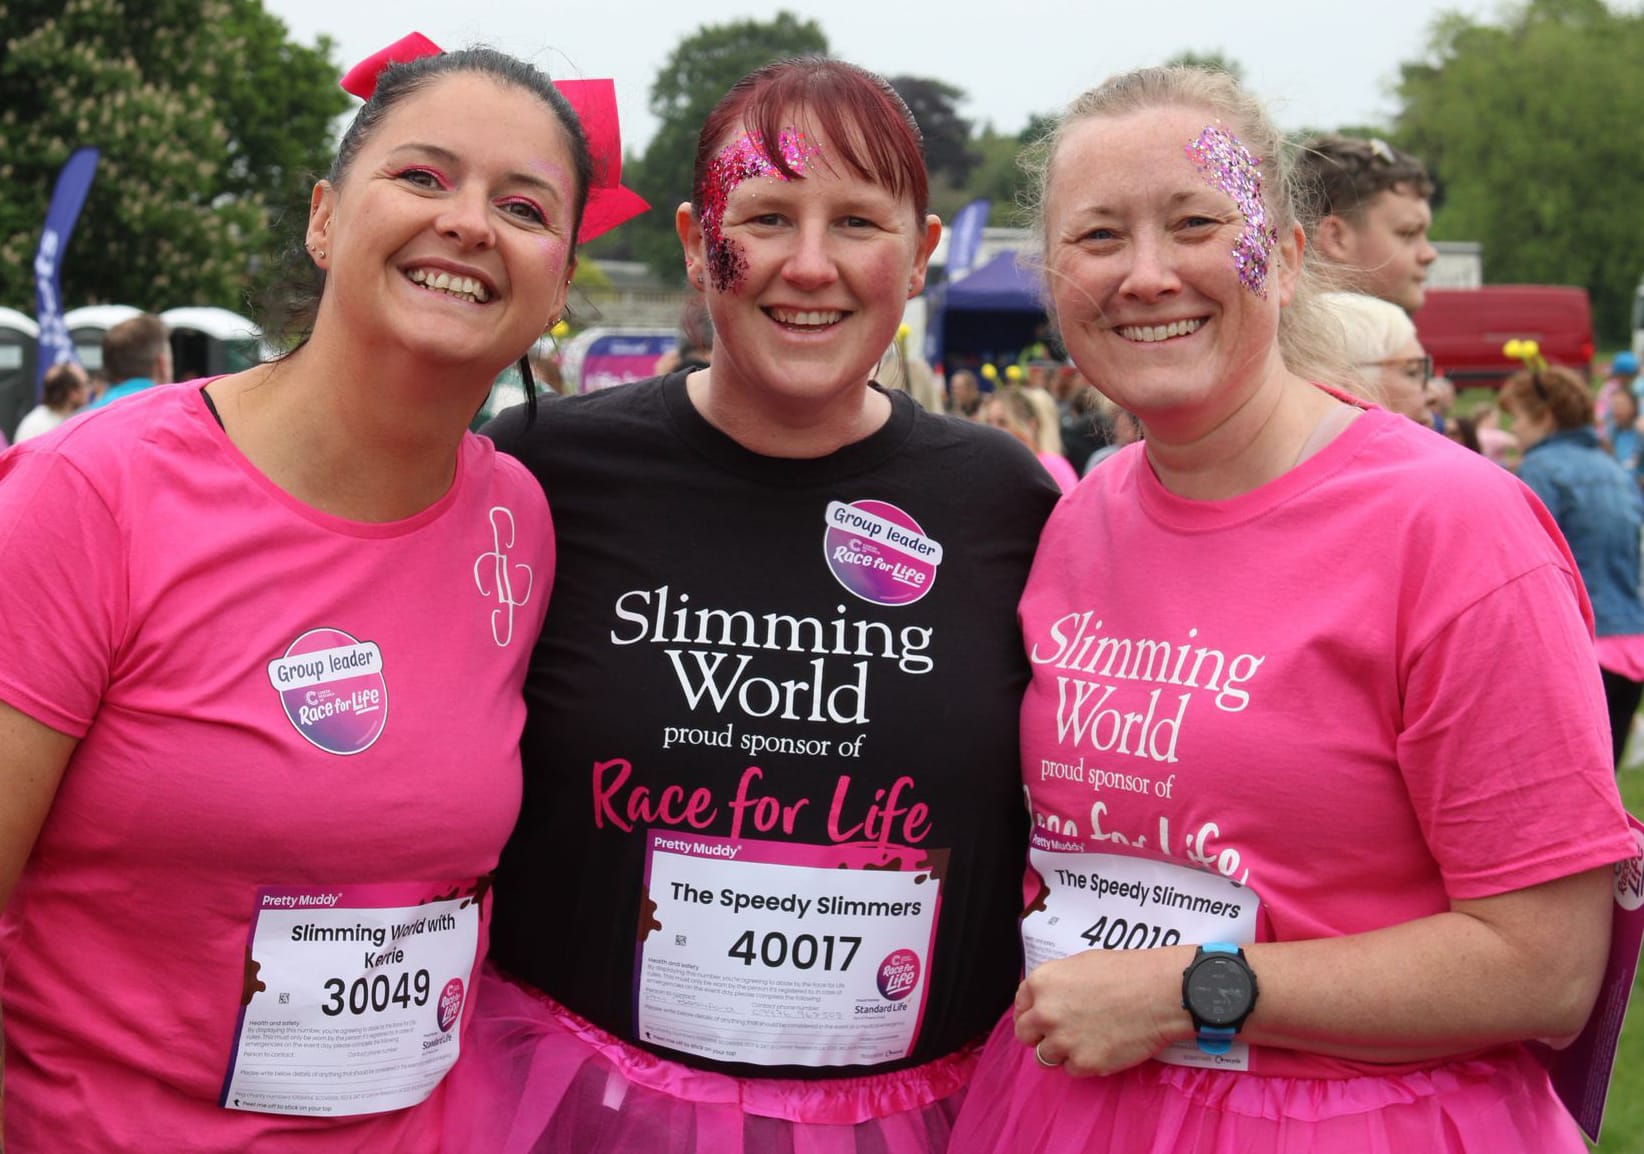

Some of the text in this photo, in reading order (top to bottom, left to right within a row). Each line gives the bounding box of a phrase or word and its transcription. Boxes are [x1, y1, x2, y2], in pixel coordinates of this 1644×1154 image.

[834, 507, 936, 556] Group leader
[833, 545, 873, 566] Race
[873, 557, 894, 572] for
[892, 562, 926, 585] Life
[610, 584, 934, 674] Slimming
[277, 650, 374, 682] Group leader
[1031, 610, 1266, 712] Slimming
[664, 649, 870, 725] World
[298, 688, 380, 726] Race for Life
[1056, 676, 1192, 763] World
[662, 724, 866, 758] proud sponsor of
[1041, 757, 1176, 799] proud sponsor of
[592, 757, 934, 845] Race for Life
[654, 836, 738, 858] Pretty Muddy
[262, 894, 338, 908] Pretty Muddy
[670, 882, 922, 919] The Speedy Slimmers
[1054, 869, 1242, 920] The Speedy Slimmers
[290, 913, 456, 947] Slimming World with
[364, 948, 404, 969] Kerrie
[727, 929, 863, 972] 40017
[882, 964, 904, 977] Race
[886, 971, 915, 992] Life
[321, 968, 430, 1016] 30049
[854, 1003, 893, 1014] Standard
[893, 1002, 908, 1012] Life
